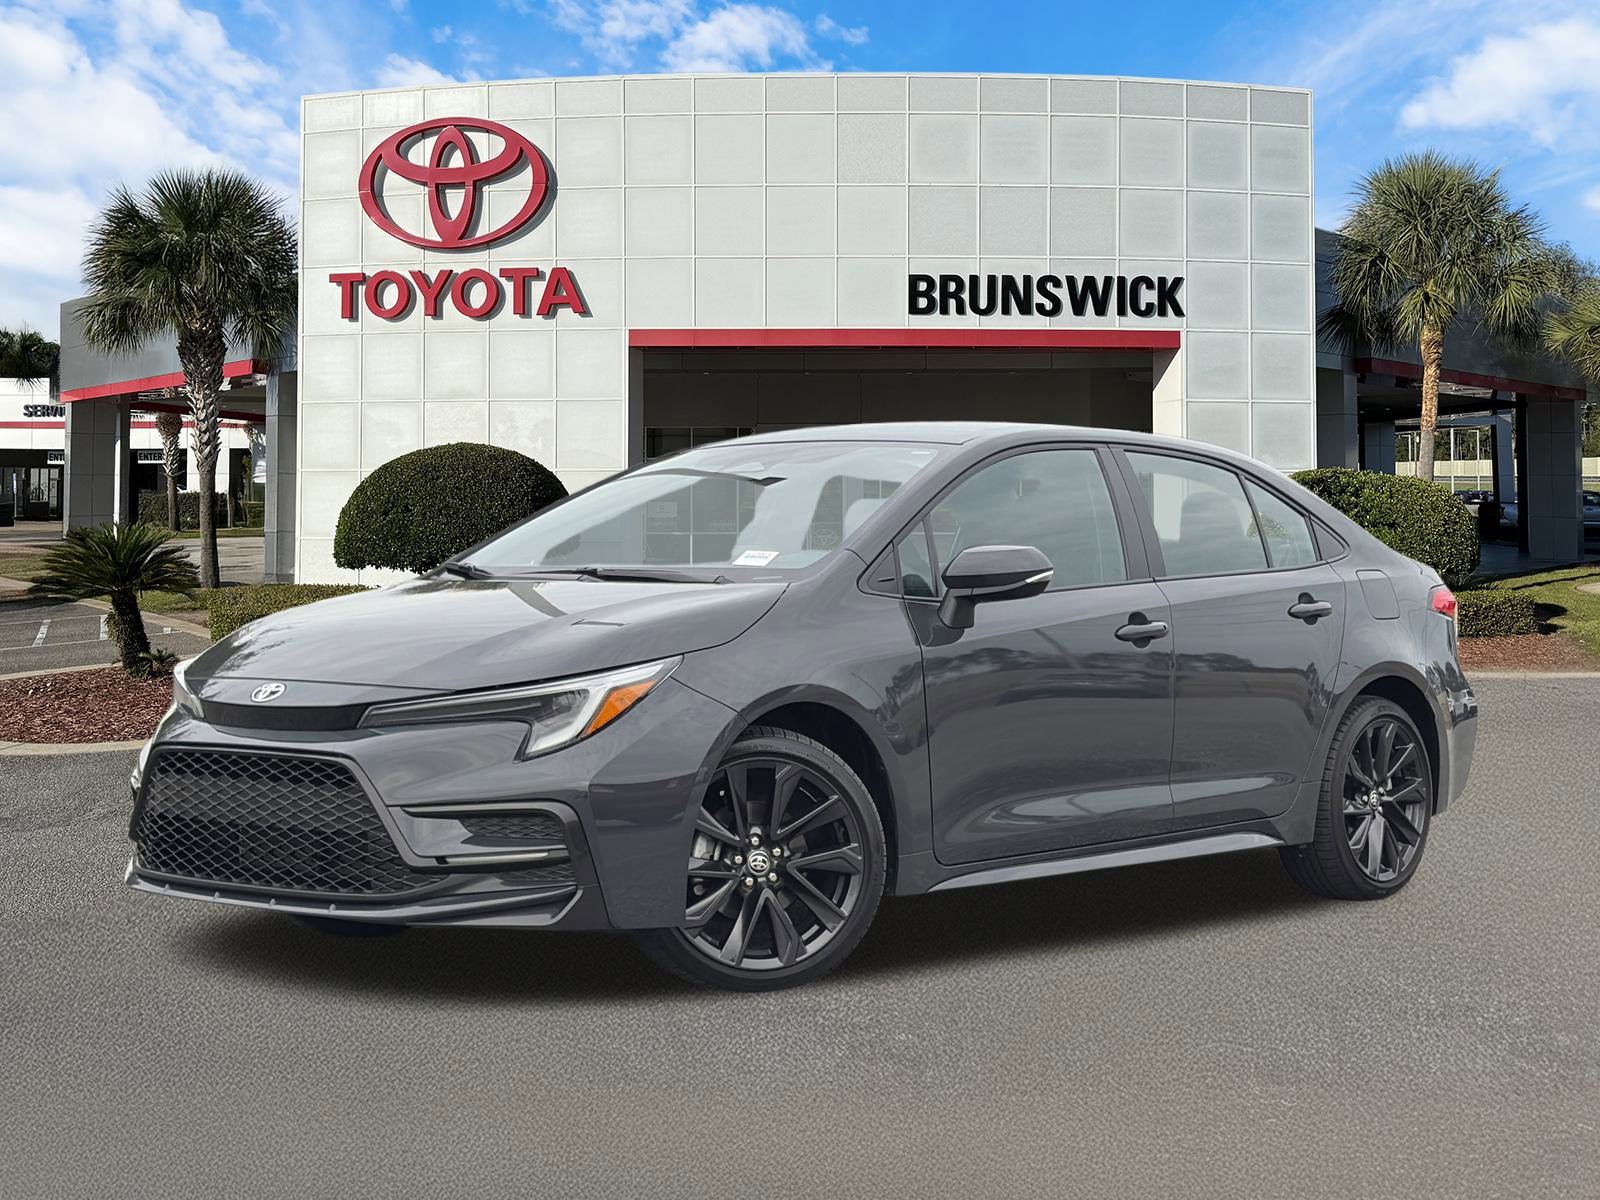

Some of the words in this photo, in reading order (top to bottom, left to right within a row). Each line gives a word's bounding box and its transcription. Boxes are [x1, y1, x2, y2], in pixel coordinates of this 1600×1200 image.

[329, 267, 587, 319] TOYOTA
[908, 274, 1185, 317] BRUNSWICK
[23, 404, 65, 417] SERVI
